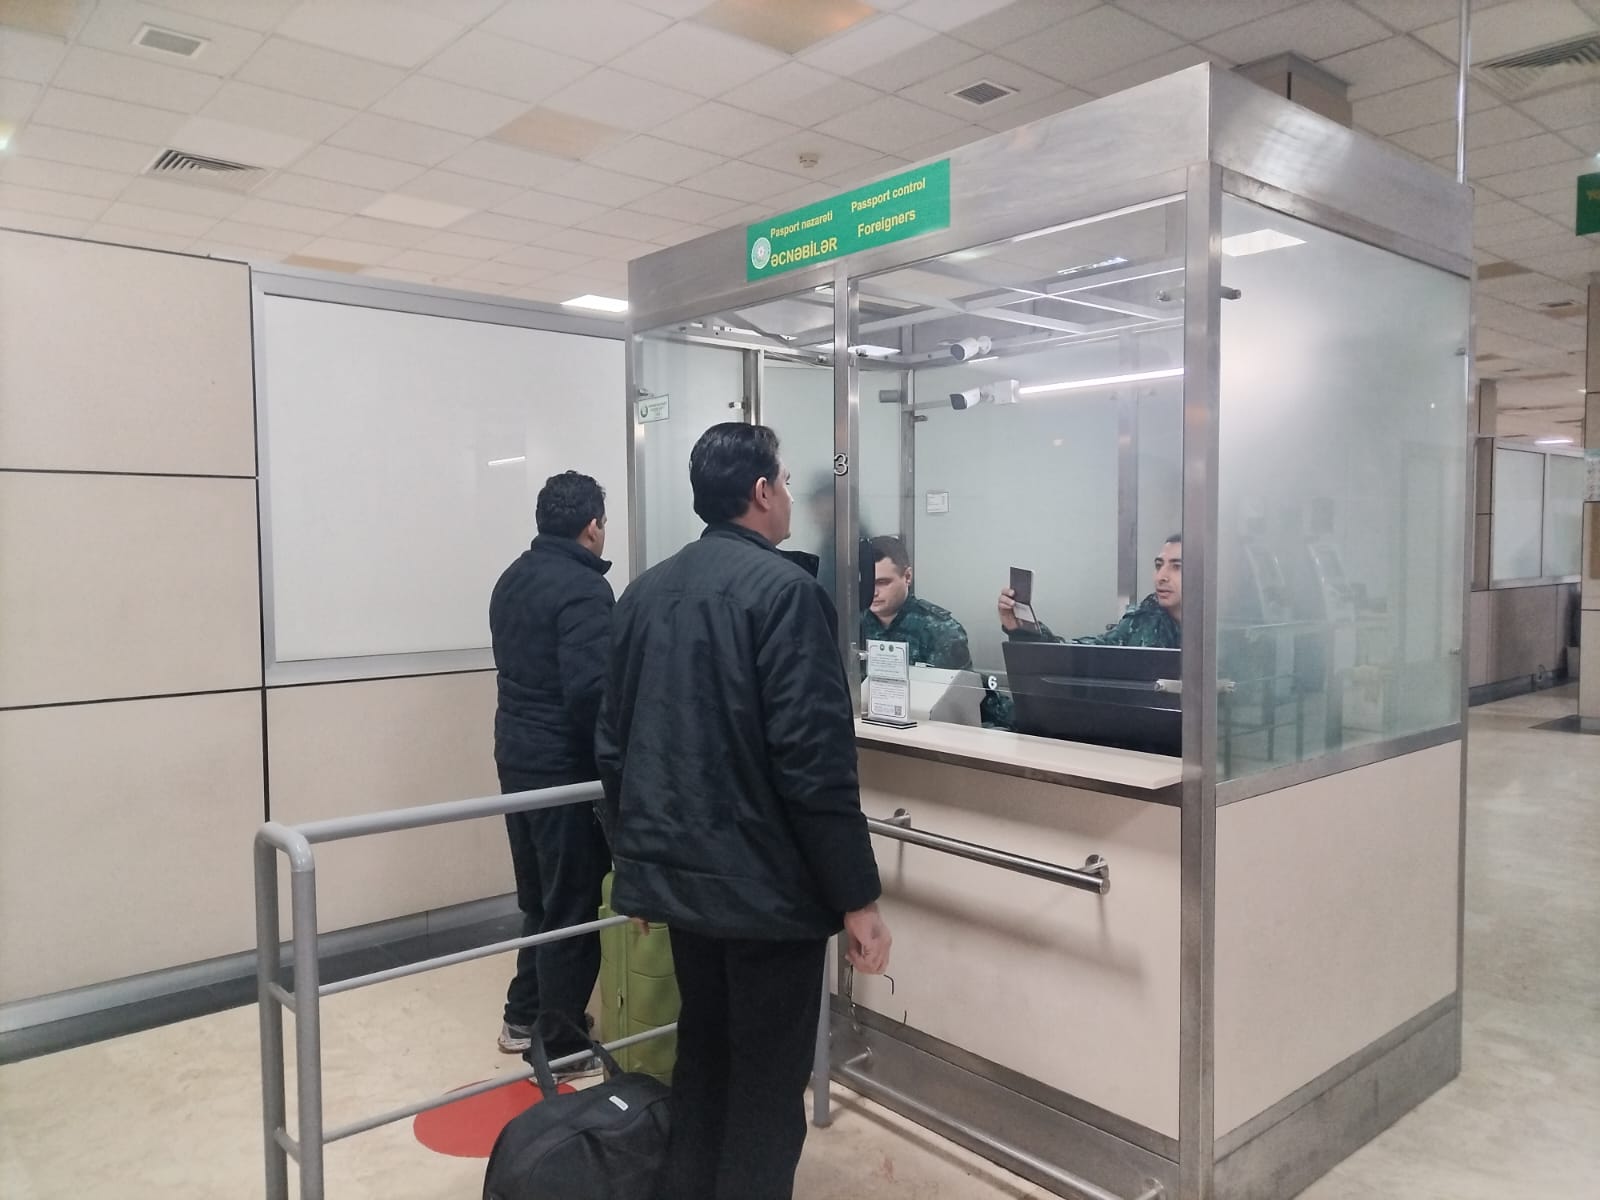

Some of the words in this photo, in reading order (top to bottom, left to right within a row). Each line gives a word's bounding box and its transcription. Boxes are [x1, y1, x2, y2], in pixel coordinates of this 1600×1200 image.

[851, 189, 890, 213] Passport
[892, 177, 926, 198] control
[770, 221, 800, 238] Pasport
[857, 209, 916, 238] Foreigners
[834, 453, 848, 476] 3
[988, 675, 998, 690] 6
